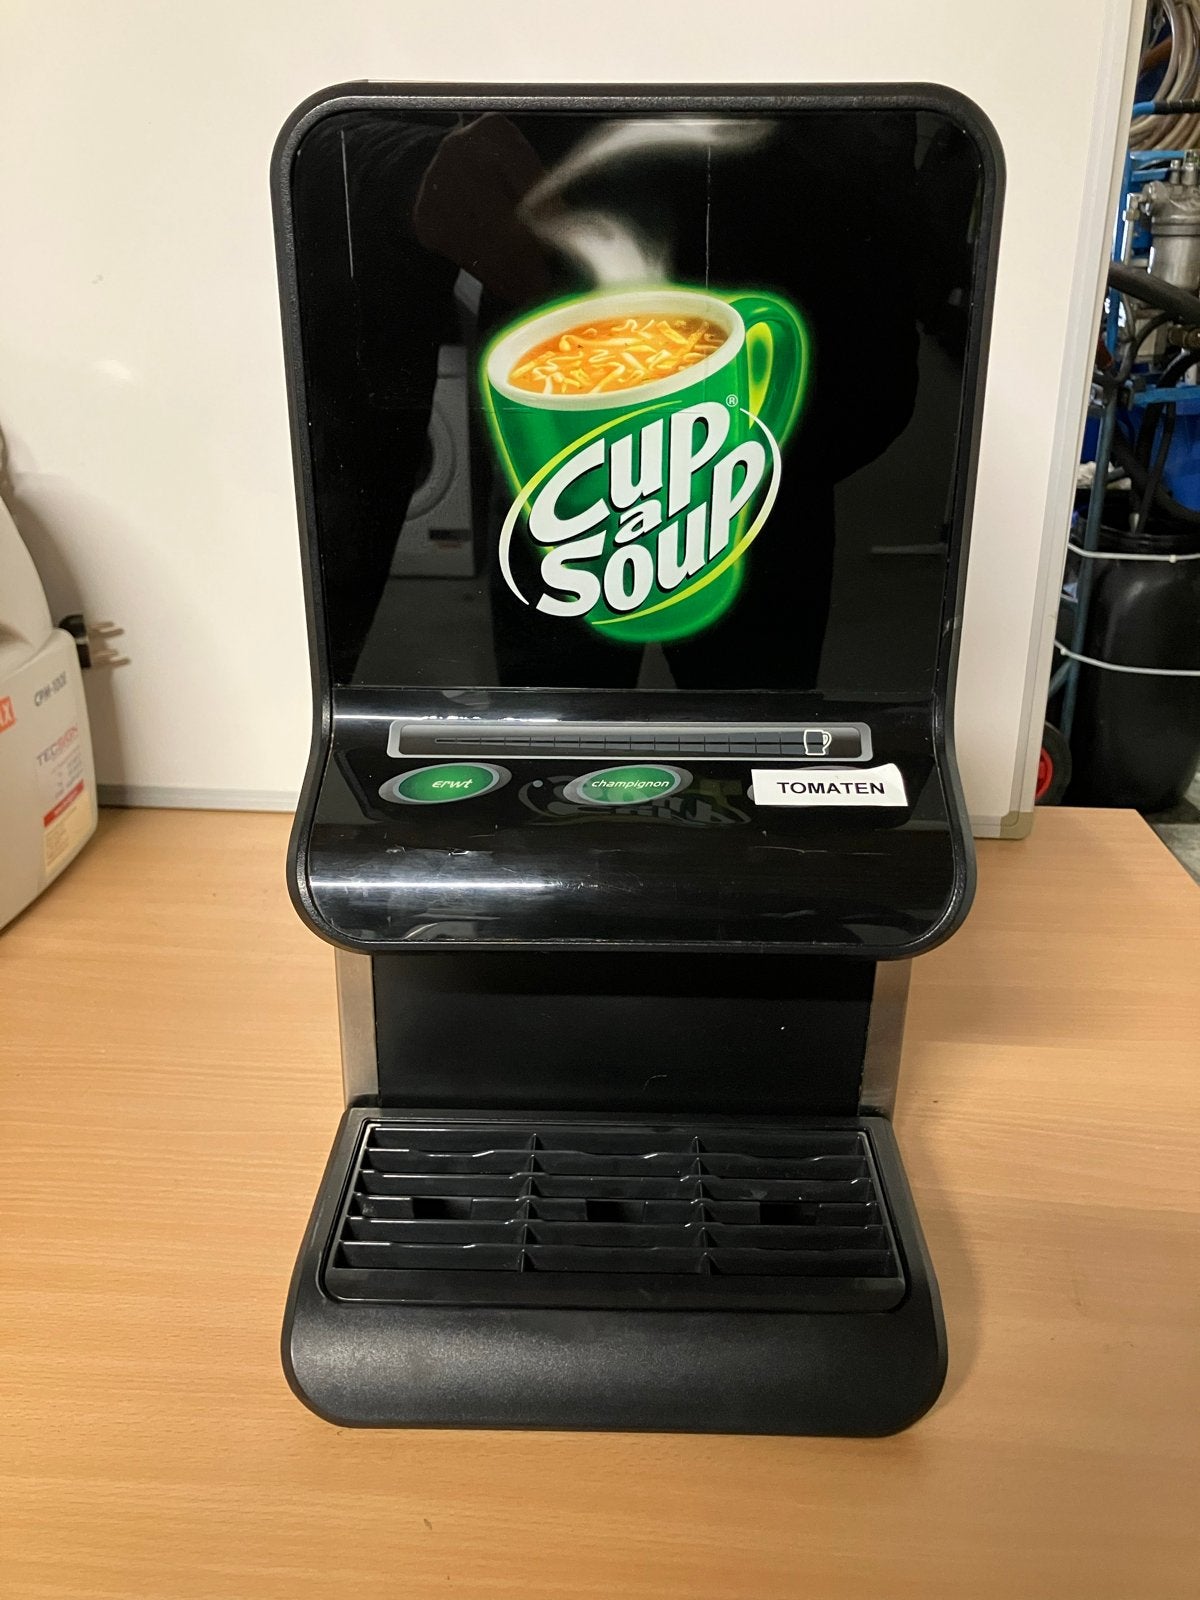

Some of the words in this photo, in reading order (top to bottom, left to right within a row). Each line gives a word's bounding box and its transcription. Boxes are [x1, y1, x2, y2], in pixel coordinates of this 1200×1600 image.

[529, 402, 730, 543] Cup
[536, 440, 766, 617] Soup
[614, 499, 662, 544] a
[431, 778, 473, 789] erwt
[591, 779, 670, 789] champignon
[777, 782, 885, 794] TOMATEN
